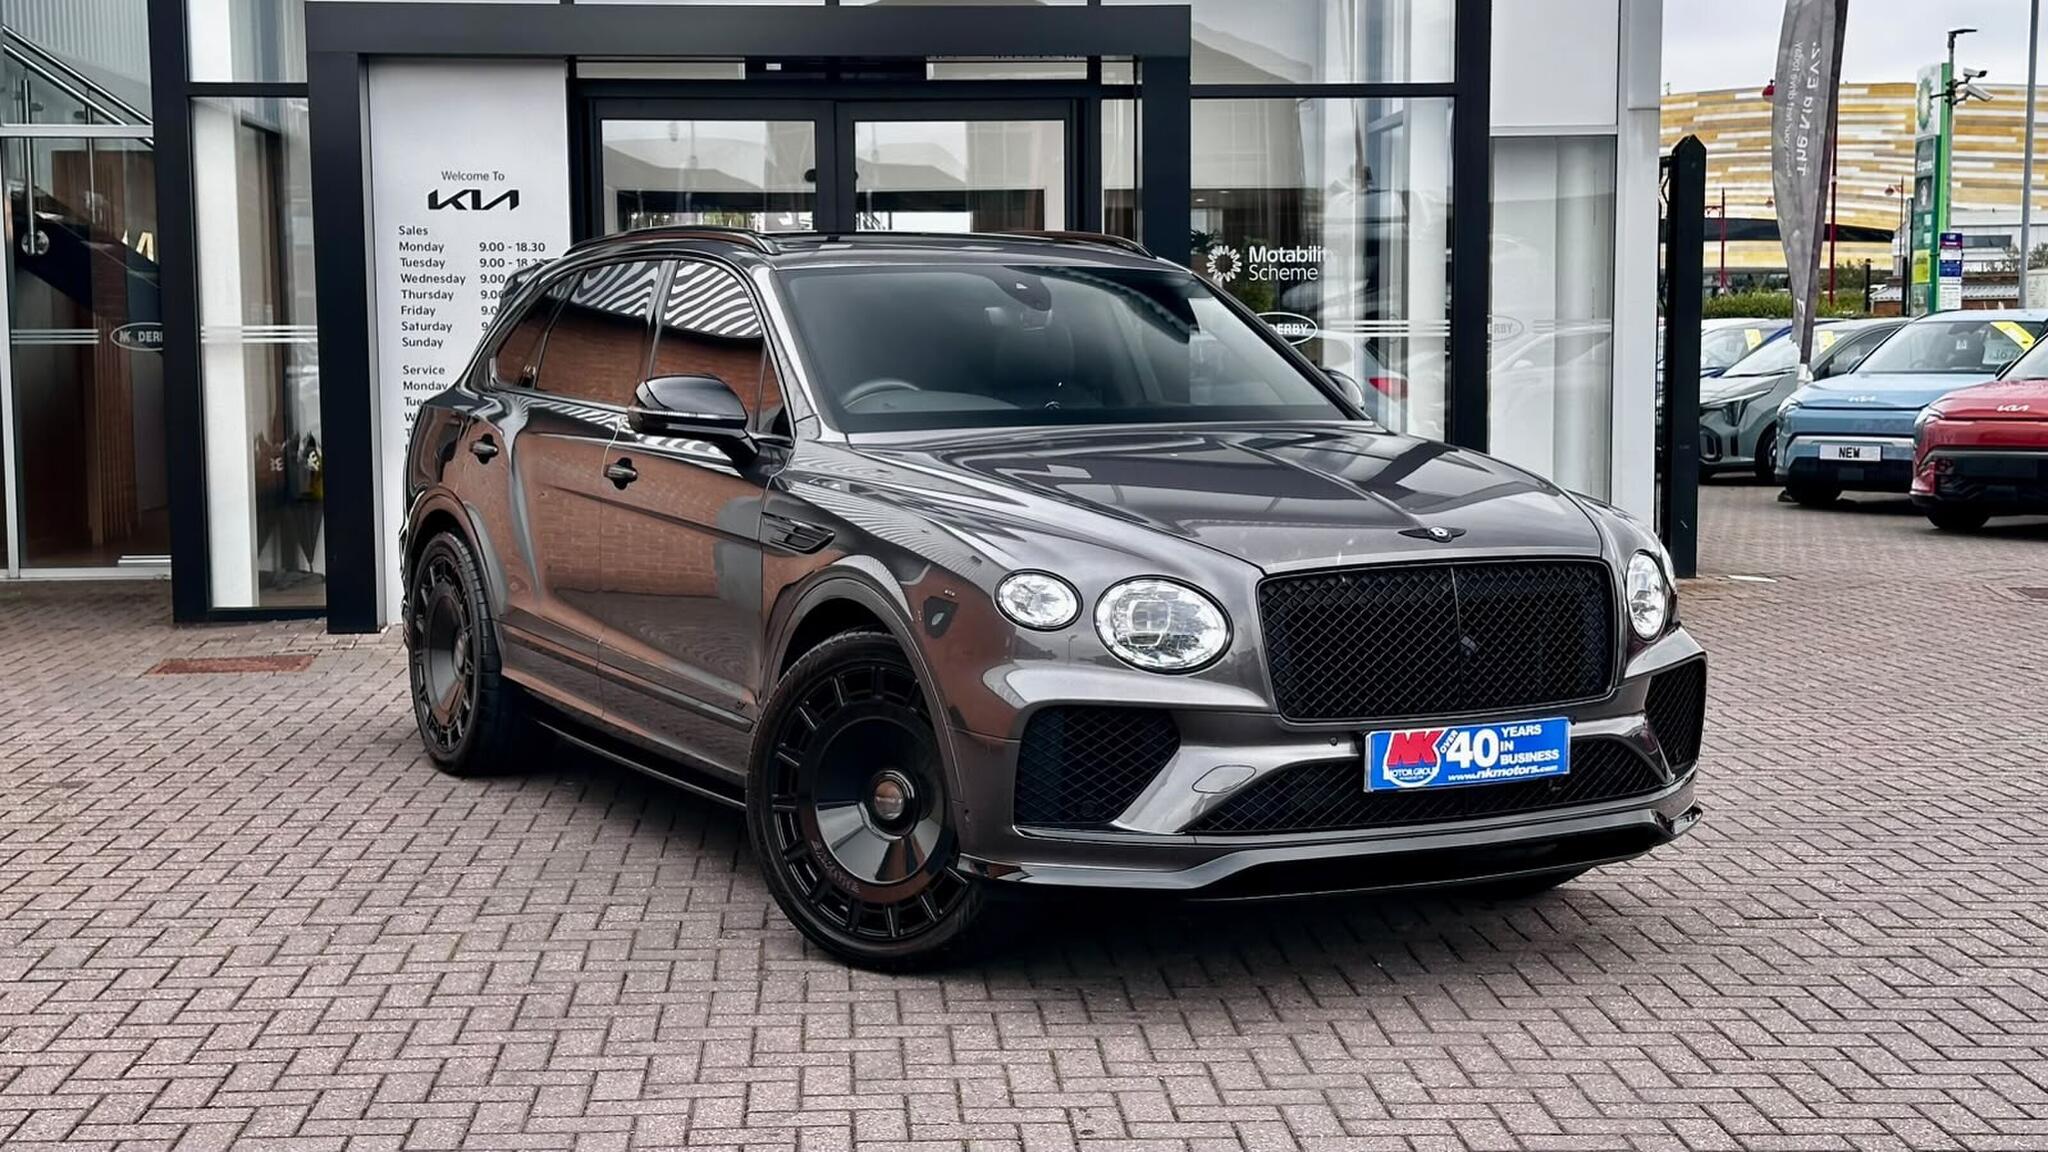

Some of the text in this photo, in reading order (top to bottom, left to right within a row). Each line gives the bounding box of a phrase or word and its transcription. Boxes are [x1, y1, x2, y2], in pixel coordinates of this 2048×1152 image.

[441, 171, 505, 181] Welcome To
[427, 189, 520, 211] KIA
[398, 225, 428, 236] Sales
[398, 241, 445, 253] Monday
[479, 242, 505, 252] 9.00
[516, 242, 546, 252] 18.30
[1249, 246, 1334, 263] Motabili
[400, 257, 446, 269] Tuesday
[479, 258, 505, 268] 9.00
[1249, 264, 1318, 281] Scheme
[400, 273, 505, 285] Wednesday 9.00
[401, 289, 454, 301] Thursday
[401, 305, 499, 317] Friday 9.0
[401, 321, 452, 333] Saturday
[402, 337, 443, 349] Sunday
[402, 365, 445, 376] Service
[1838, 446, 1860, 459] NEW
[1501, 724, 1542, 738] YEARS
[1440, 730, 1459, 754] OVER
[1500, 740, 1514, 752] IN
[1446, 728, 1499, 769] 40
[1500, 749, 1560, 765] BUSINESS
[1448, 765, 1558, 781] www.nkmotors.com
